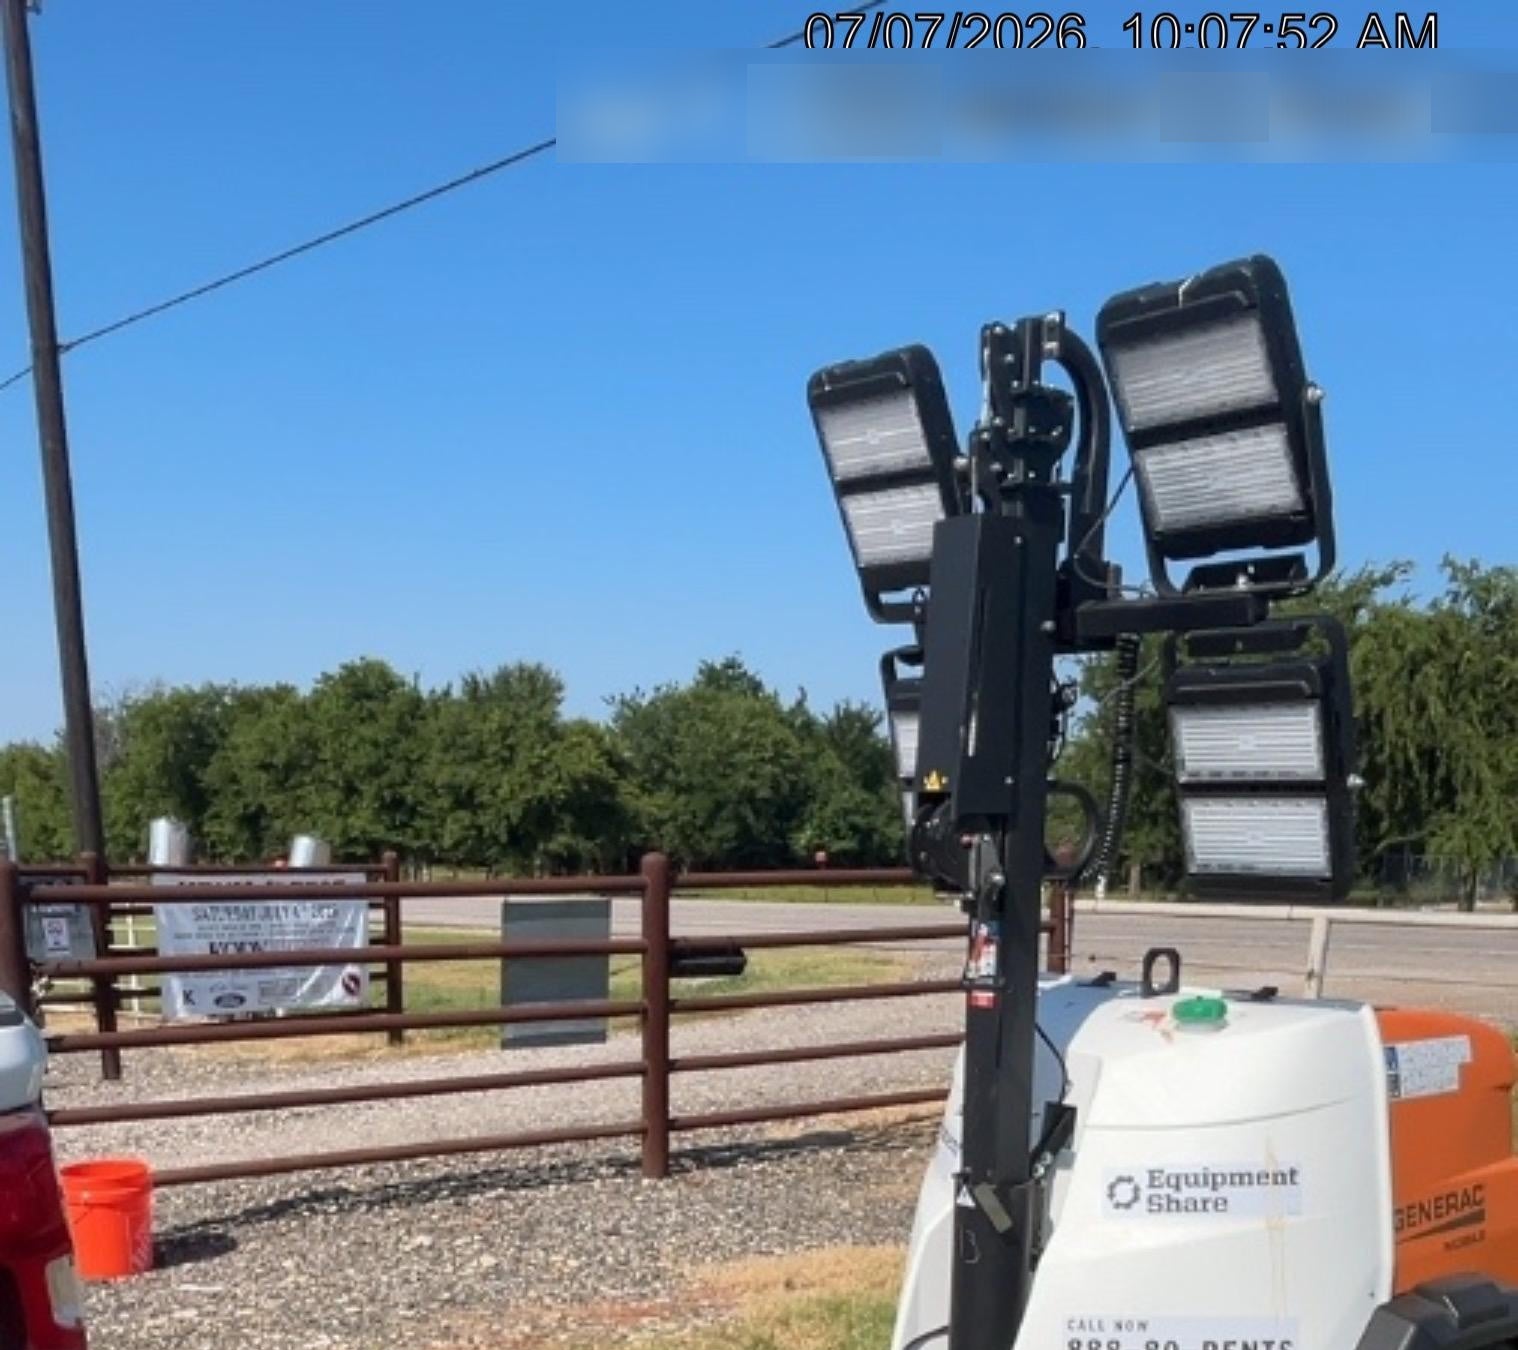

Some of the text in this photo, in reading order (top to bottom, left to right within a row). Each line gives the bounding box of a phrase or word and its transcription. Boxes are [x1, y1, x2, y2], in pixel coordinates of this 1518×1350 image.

[1146, 1167, 1299, 1191] Equipment
[1146, 1195, 1229, 1213] Share
[1393, 1184, 1485, 1232] GENERAC
[1067, 1319, 1149, 1332] CALL NOW
